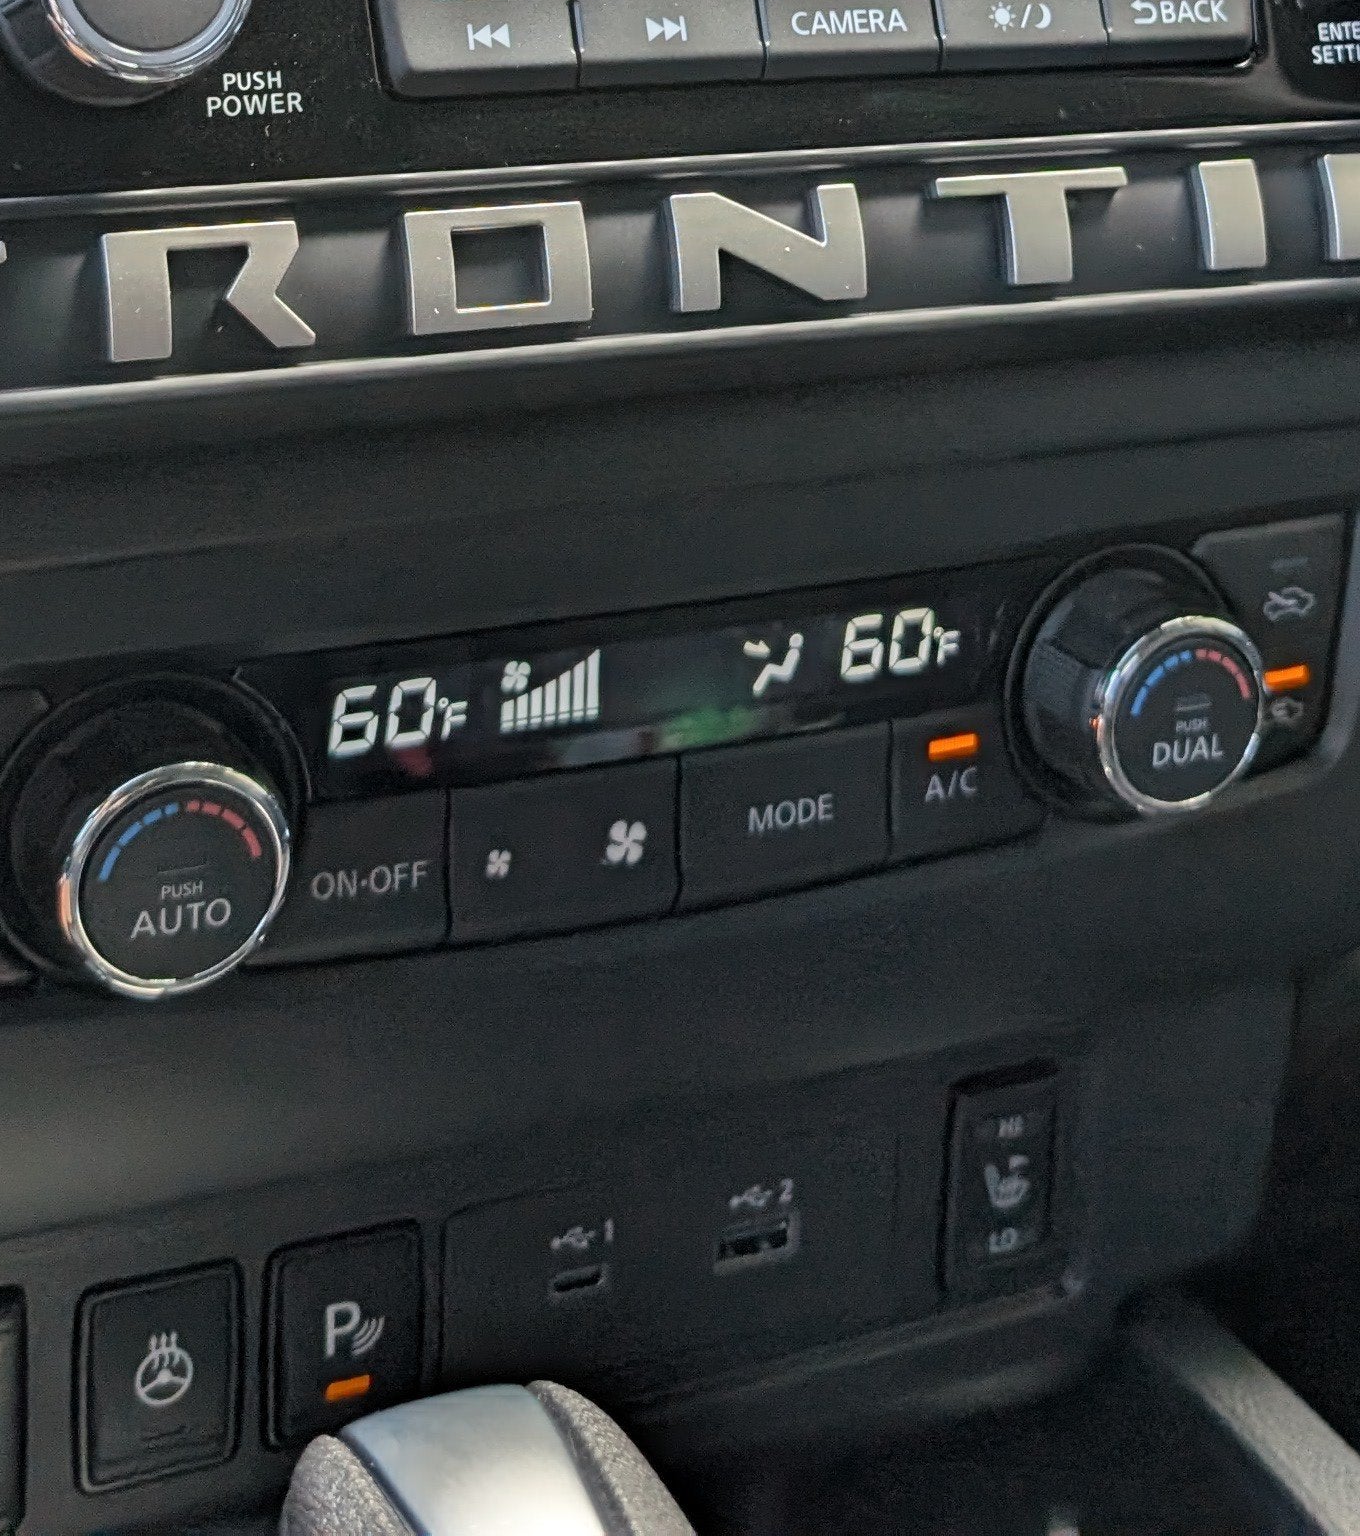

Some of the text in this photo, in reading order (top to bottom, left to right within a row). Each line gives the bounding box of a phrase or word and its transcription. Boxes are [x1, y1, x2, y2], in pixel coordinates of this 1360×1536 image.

[791, 8, 909, 37] CAMERA
[221, 69, 283, 93] PUSH
[206, 91, 304, 119] POWER
[1152, 733, 1224, 768] DUAL
[924, 766, 978, 804] A/C
[748, 792, 835, 835] MODE
[160, 879, 204, 900] PUSH
[130, 897, 232, 940] AUTO
[778, 1177, 795, 1204] 2
